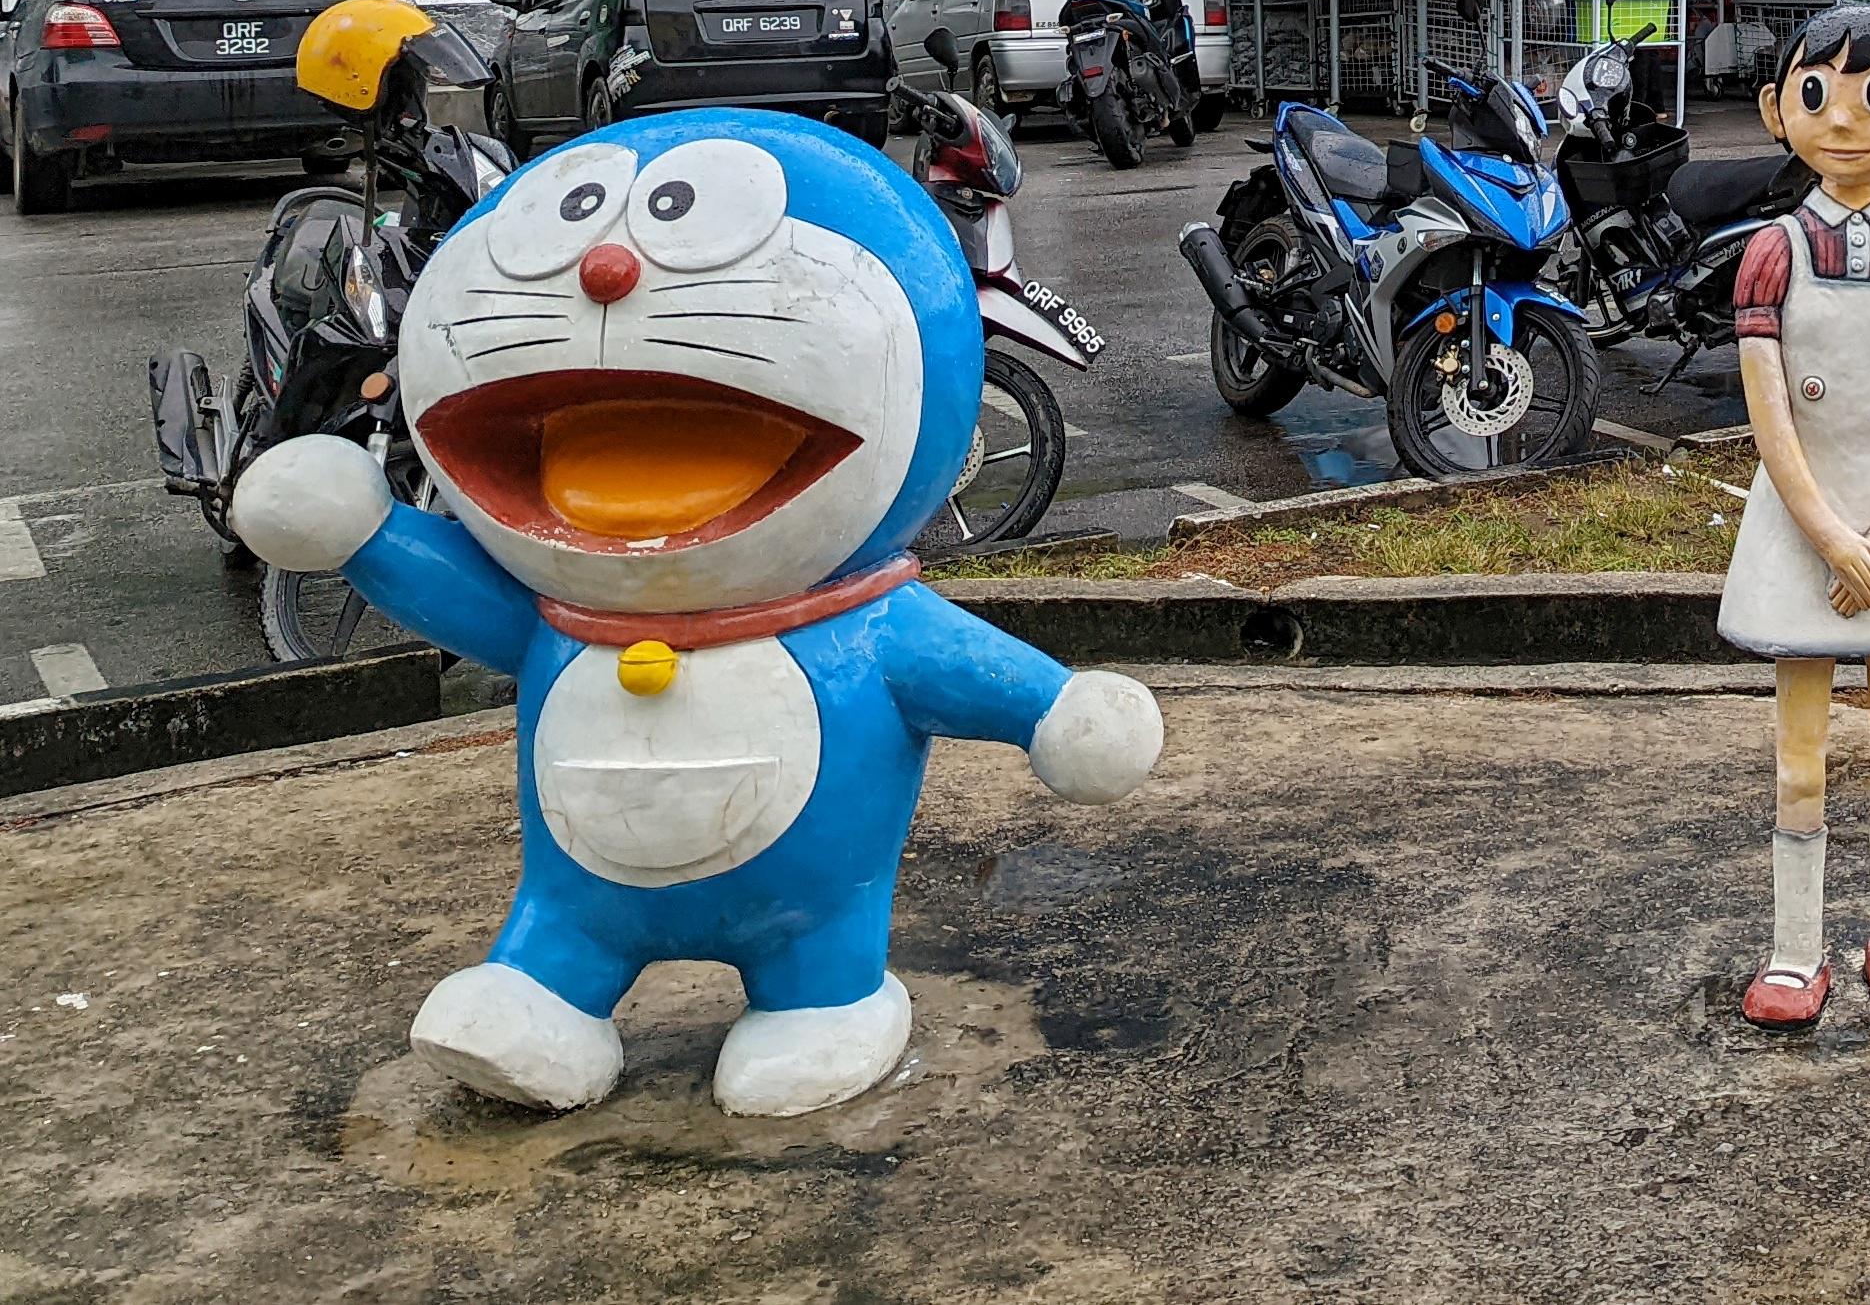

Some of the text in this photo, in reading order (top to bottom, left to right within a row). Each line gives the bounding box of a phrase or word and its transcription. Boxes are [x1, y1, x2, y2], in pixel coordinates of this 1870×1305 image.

[223, 21, 264, 39] QRF
[723, 16, 801, 32] QRF 6239
[216, 38, 270, 55] 3292
[1023, 281, 1106, 353] QRF 9965
